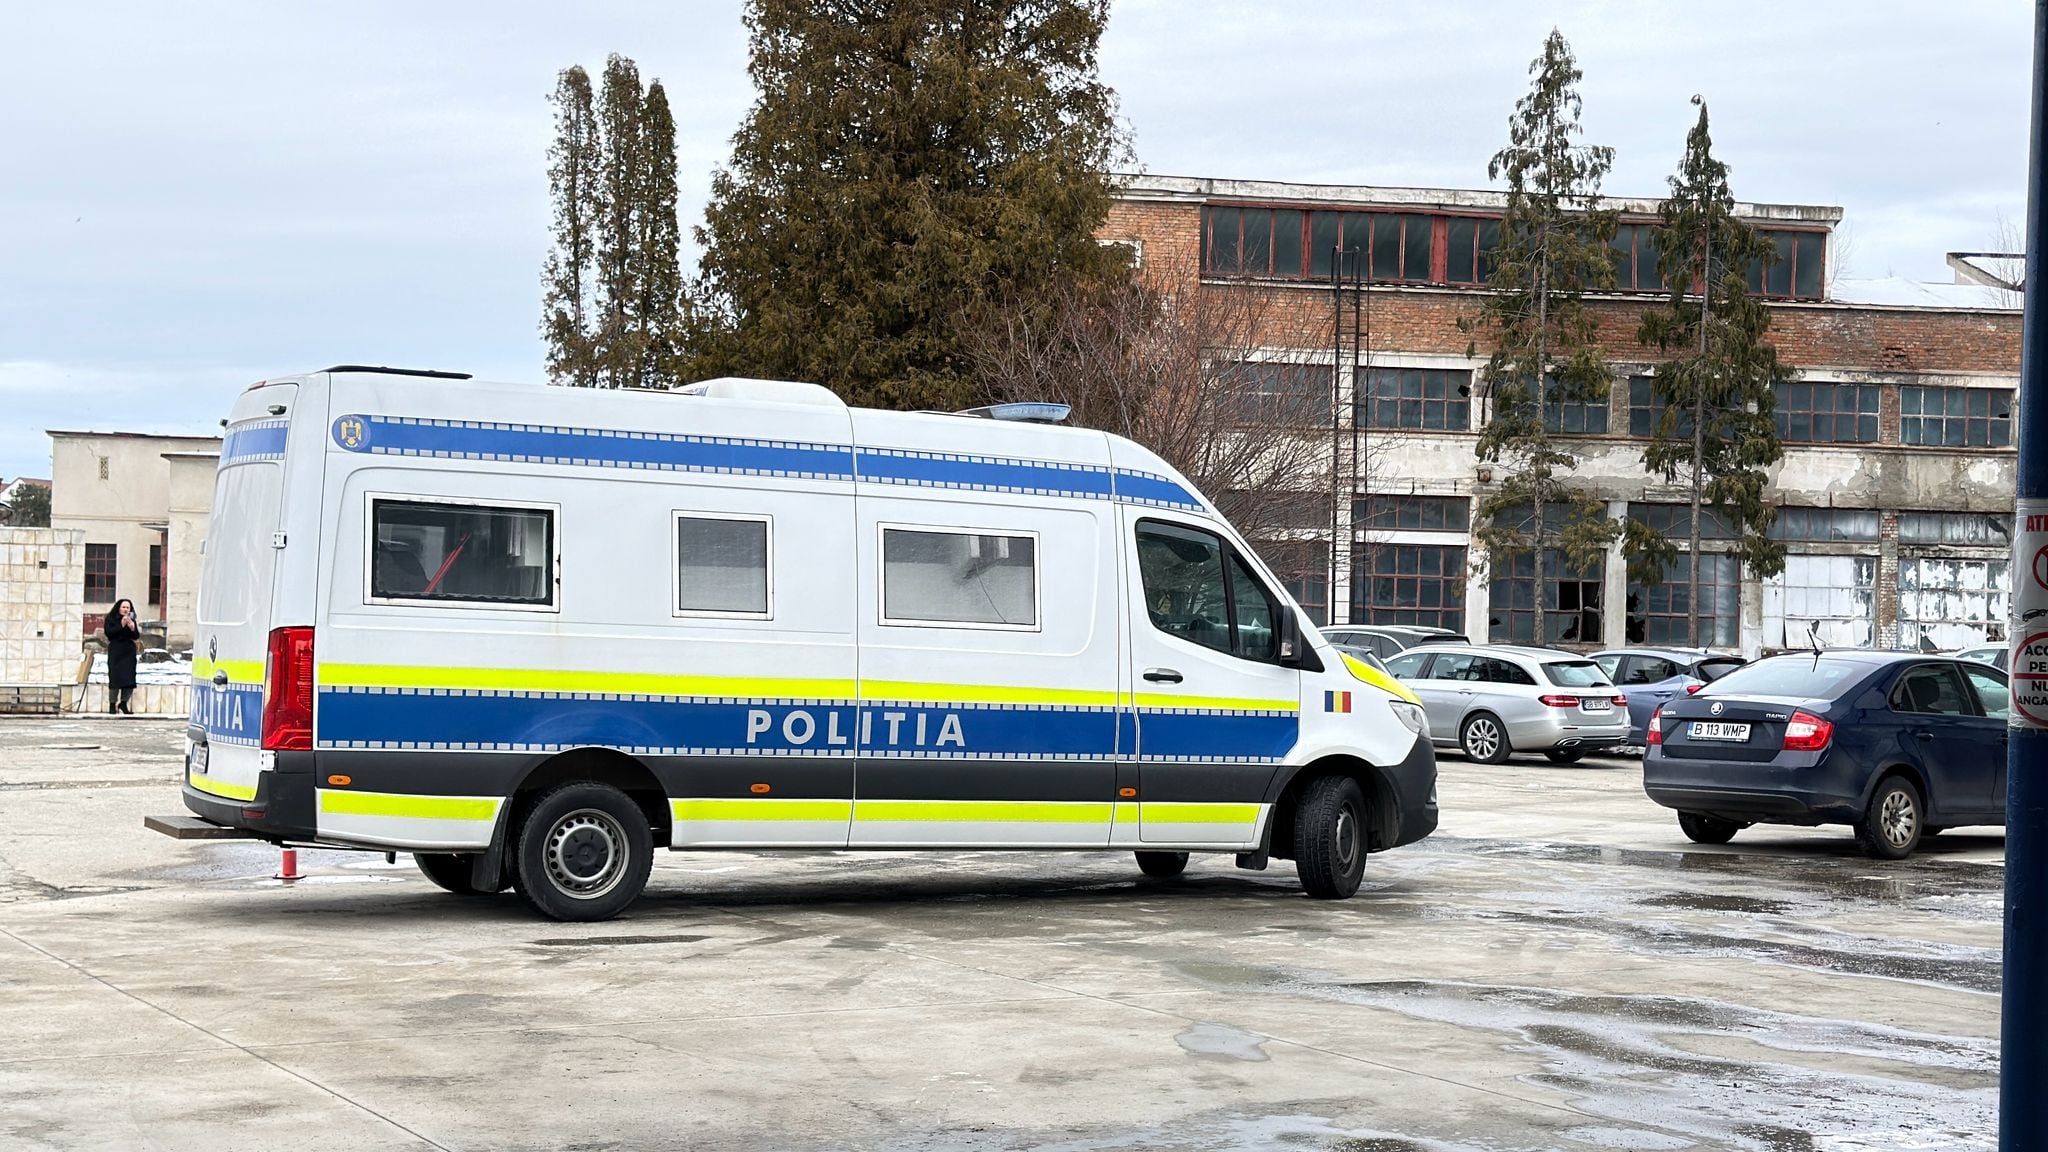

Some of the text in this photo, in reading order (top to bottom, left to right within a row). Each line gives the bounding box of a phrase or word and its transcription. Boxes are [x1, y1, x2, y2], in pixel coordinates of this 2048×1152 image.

[746, 709, 966, 747] POLITIA
[1694, 723, 1747, 737] B 113 WMP
